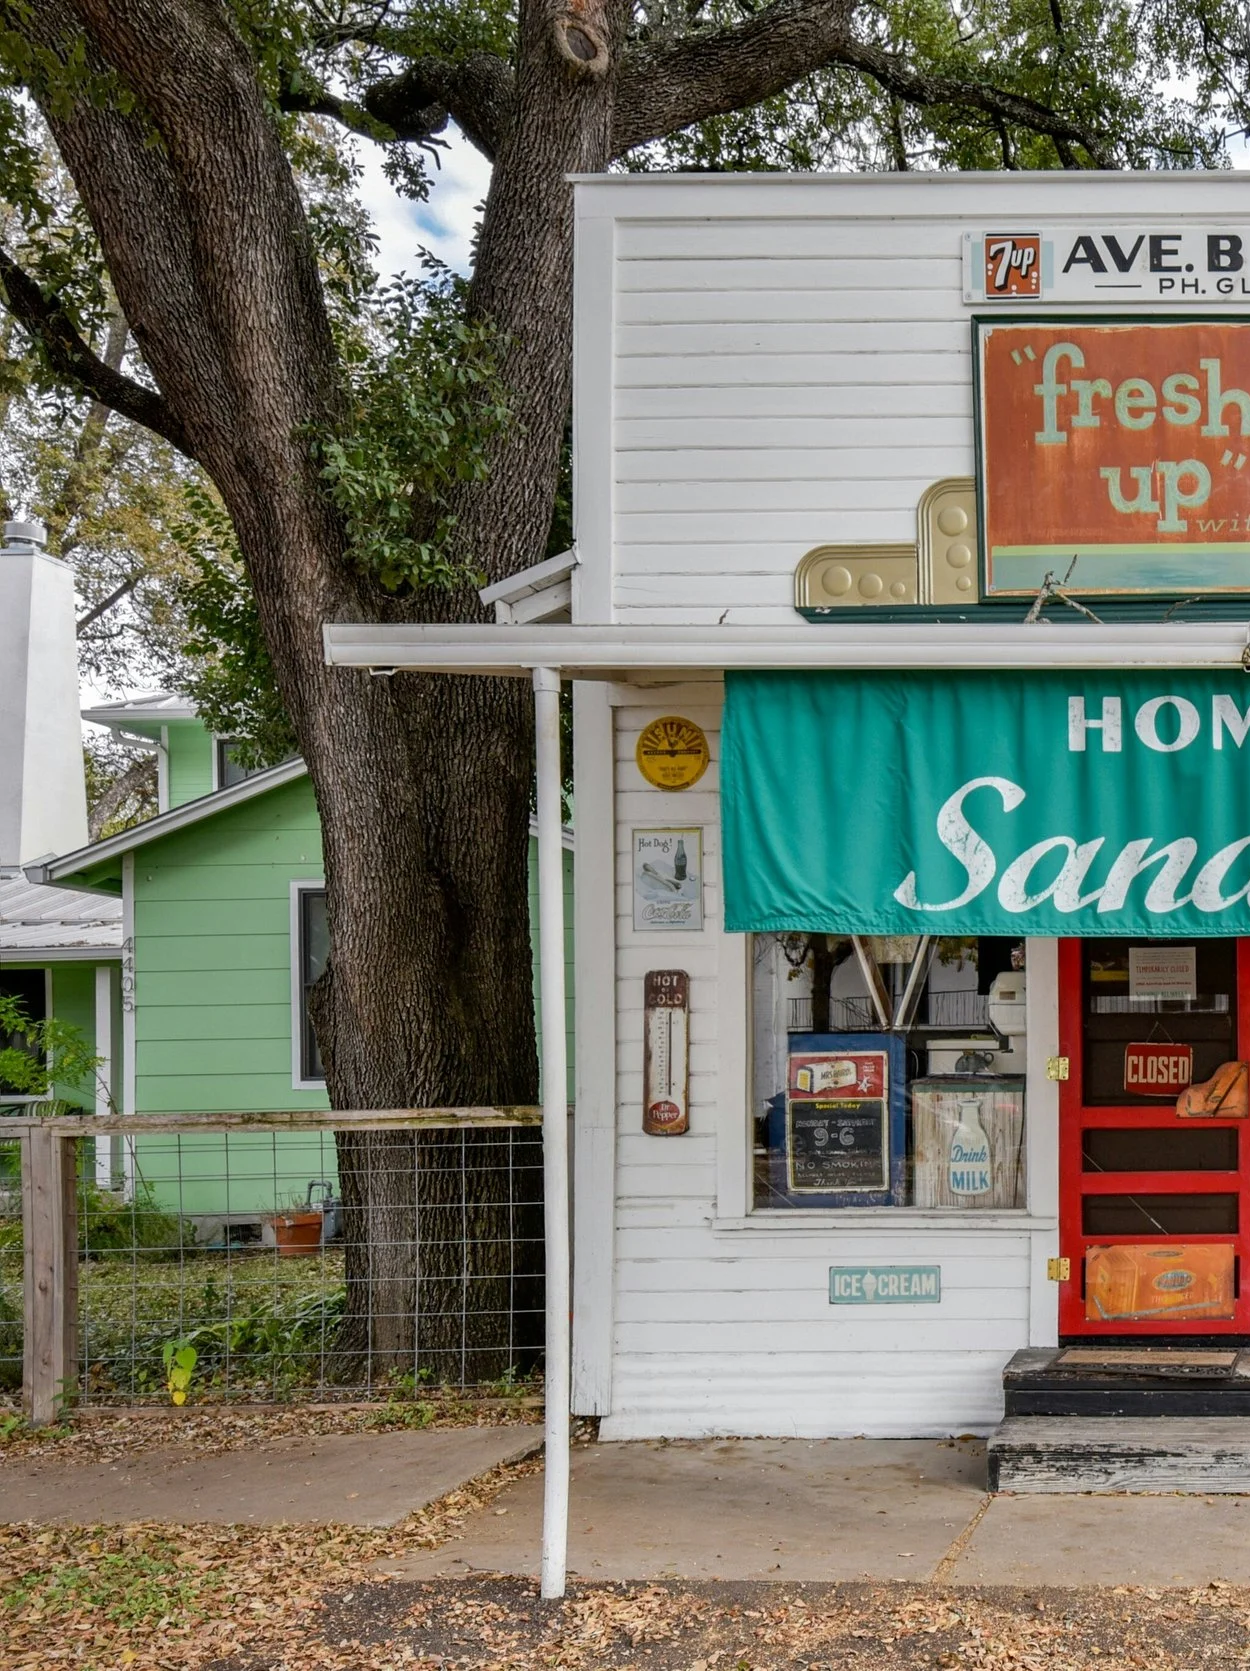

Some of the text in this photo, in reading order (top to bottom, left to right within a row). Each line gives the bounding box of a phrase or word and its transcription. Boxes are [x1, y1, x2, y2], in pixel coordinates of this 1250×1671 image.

[1062, 234, 1195, 273] AVE.
[1206, 234, 1244, 272] B
[1159, 277, 1207, 294] PH.
[121, 936, 135, 1013] 4405
[653, 975, 679, 987] HOT
[1127, 1055, 1189, 1084] CLOSED
[652, 1110, 679, 1121] Pepper
[951, 1144, 988, 1163] Drink
[795, 1161, 816, 1170] NO
[952, 1170, 989, 1191] MILK
[834, 1273, 936, 1297] ICE CREAM
